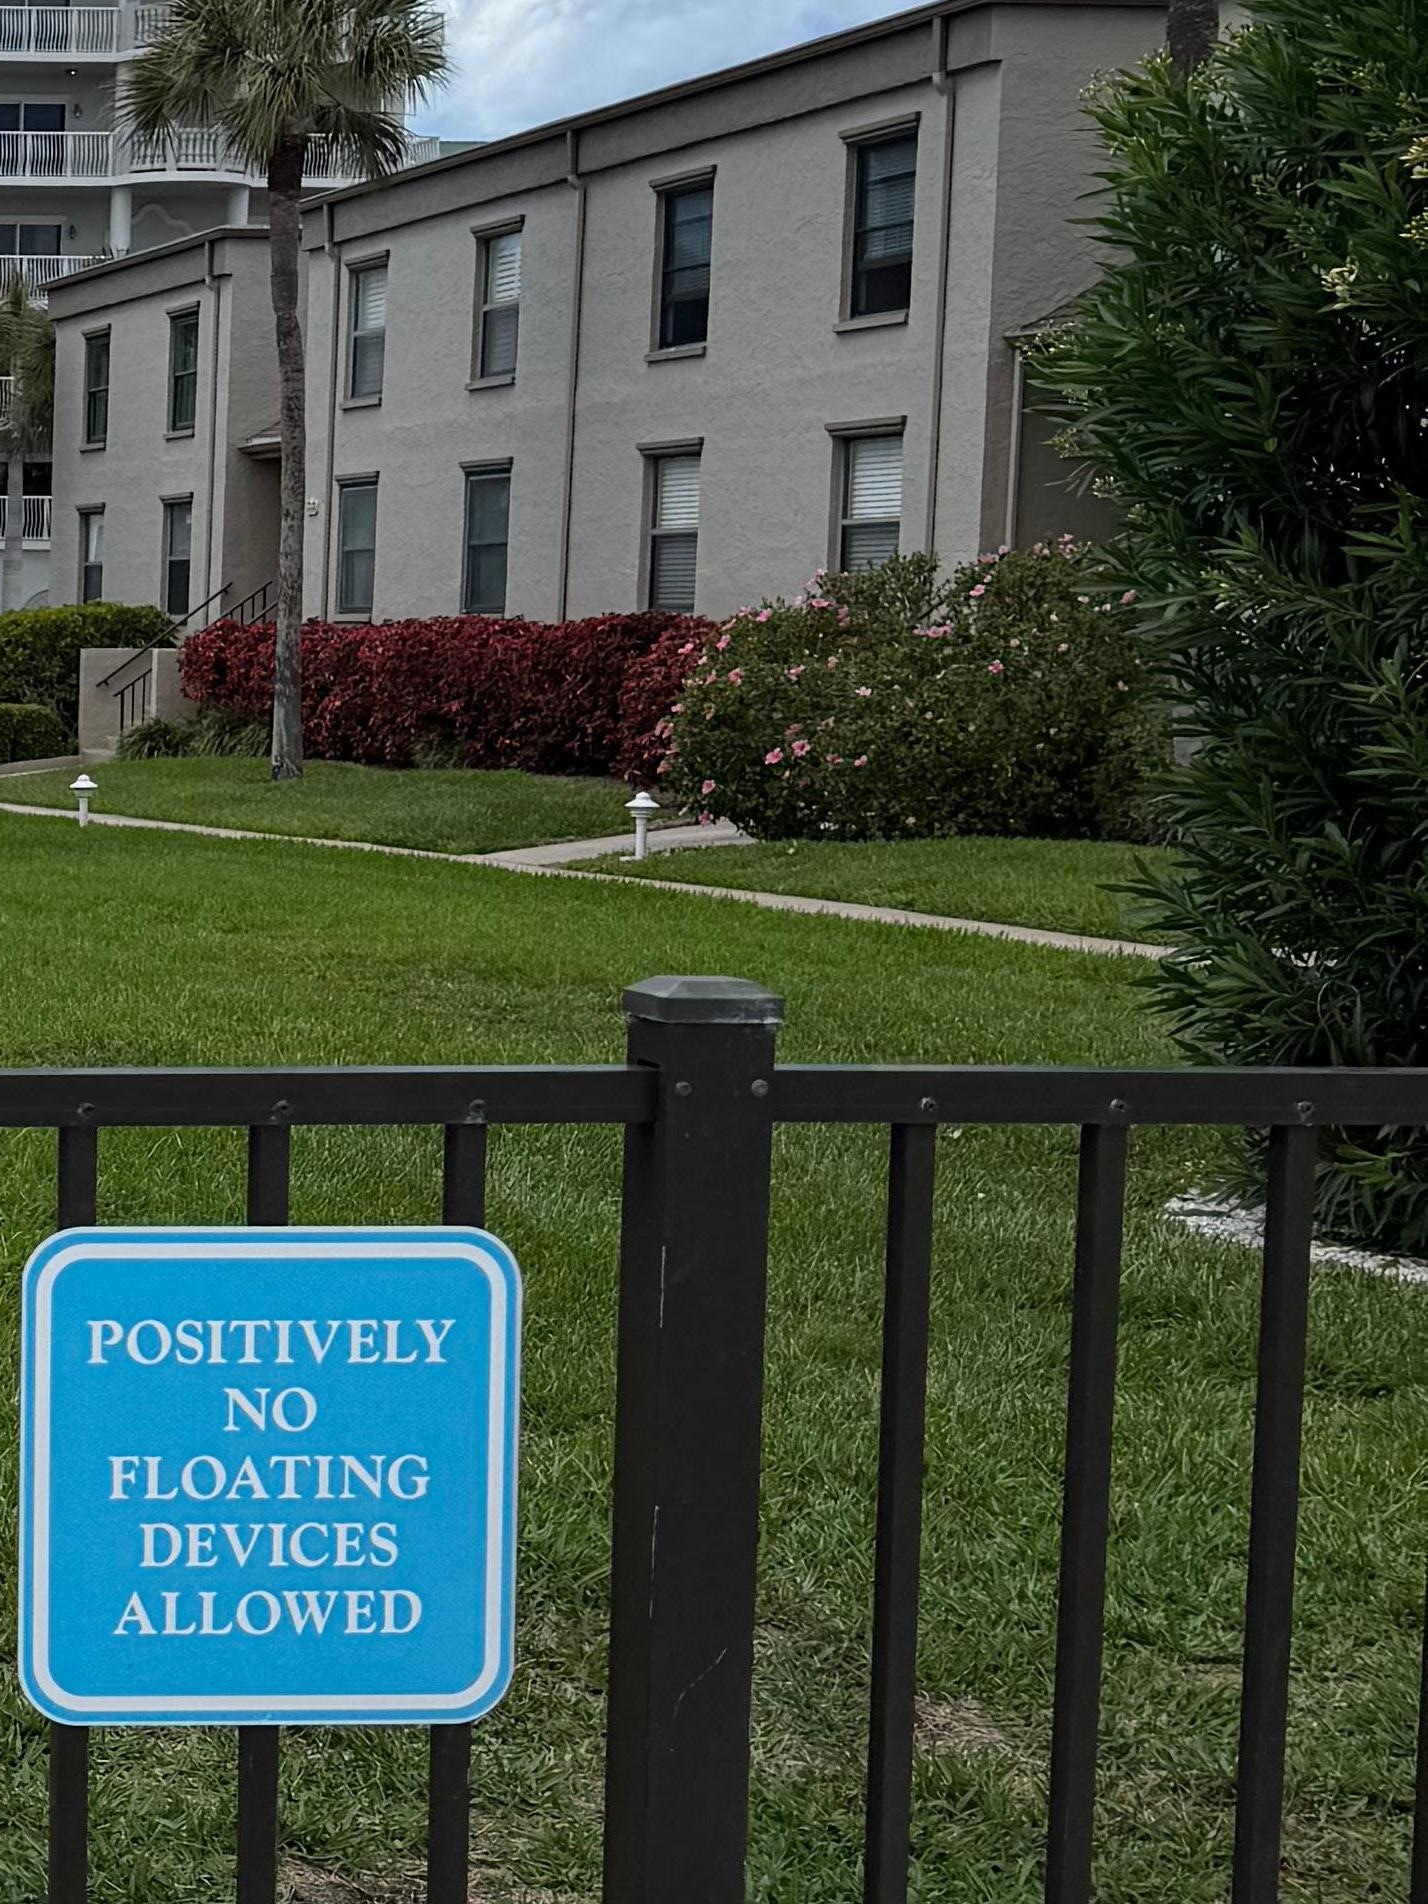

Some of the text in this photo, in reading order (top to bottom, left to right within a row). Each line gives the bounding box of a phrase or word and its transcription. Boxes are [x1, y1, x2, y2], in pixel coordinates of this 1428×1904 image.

[87, 1319, 455, 1365] POSITIVELY
[223, 1387, 317, 1433] NO
[108, 1454, 430, 1500] FLOATING
[139, 1522, 399, 1568] DEVICES
[113, 1589, 423, 1636] ALLOWED
